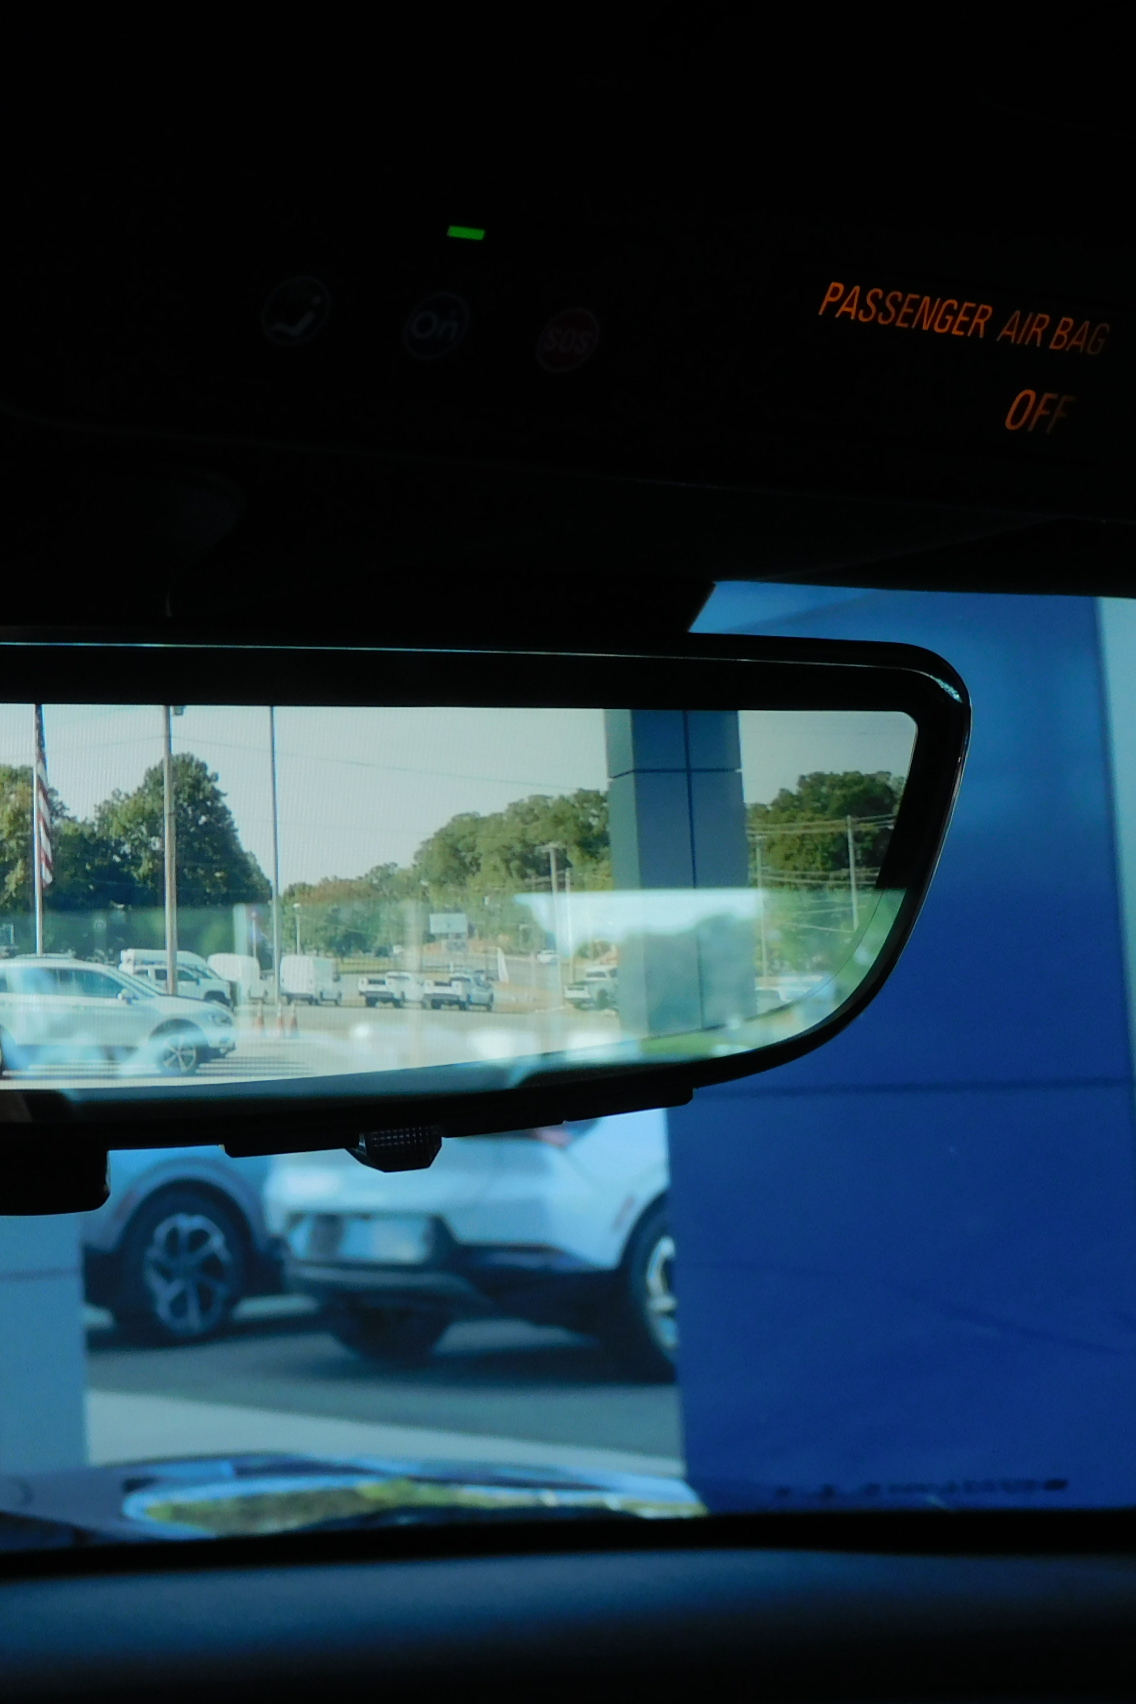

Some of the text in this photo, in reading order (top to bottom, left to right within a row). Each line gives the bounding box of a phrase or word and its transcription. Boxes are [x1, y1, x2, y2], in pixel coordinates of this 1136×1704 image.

[544, 327, 593, 355] SOS
[818, 282, 1110, 356] PASSENGER AIR BAG
[1005, 389, 1076, 433] OFF
